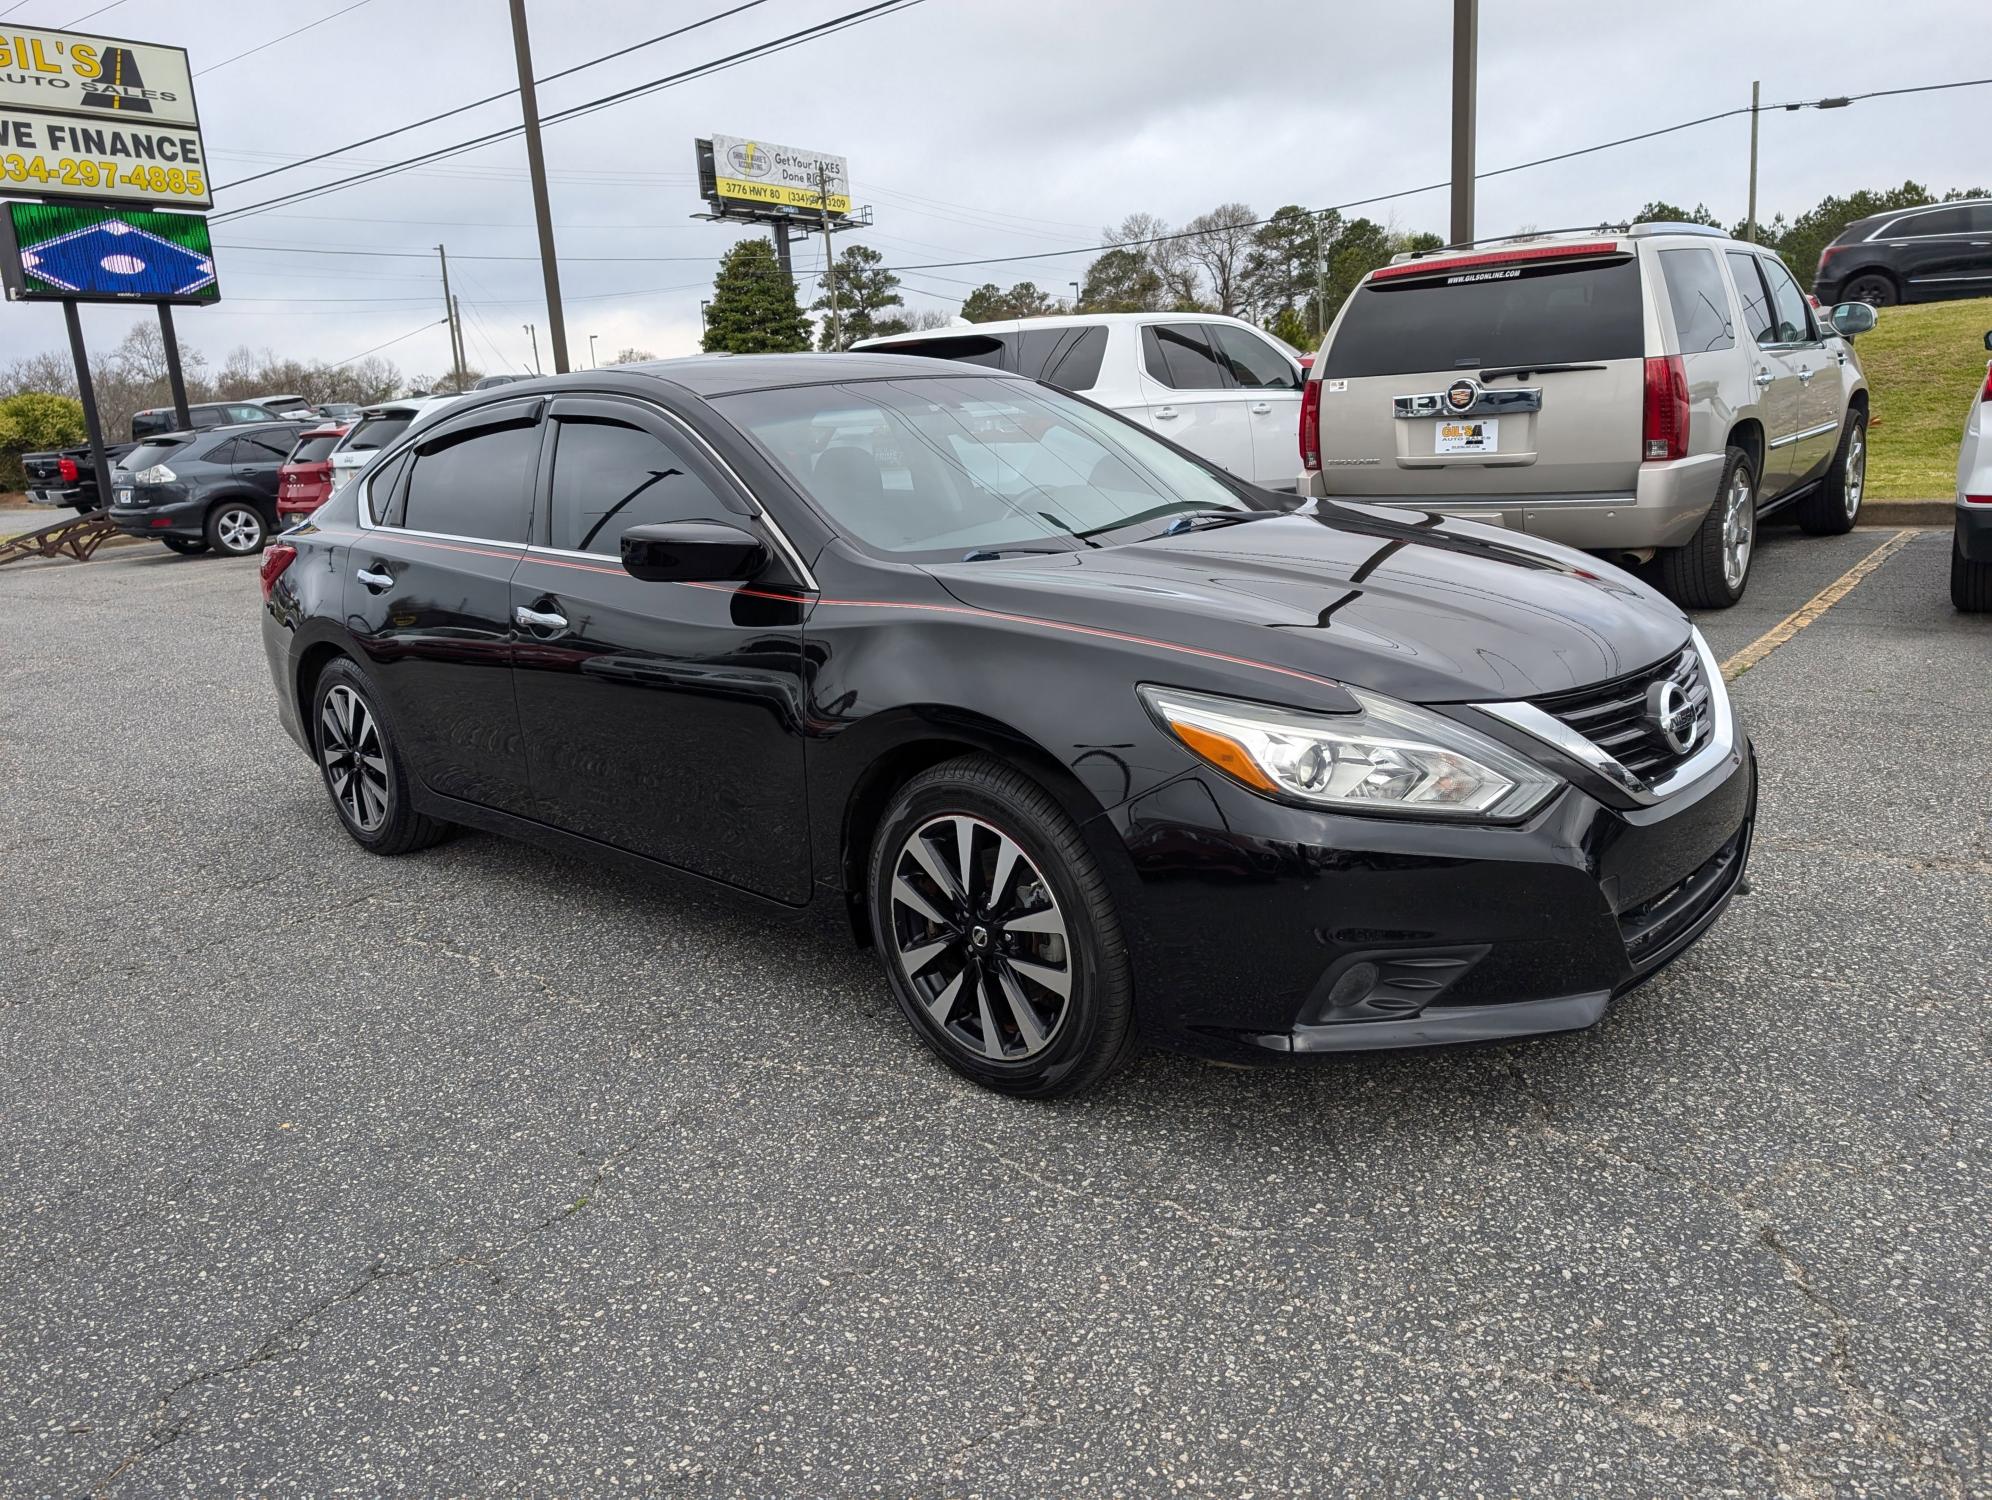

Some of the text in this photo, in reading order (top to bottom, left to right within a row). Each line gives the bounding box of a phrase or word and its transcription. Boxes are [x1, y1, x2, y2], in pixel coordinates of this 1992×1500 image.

[0, 73, 177, 101] UTO SALES
[46, 124, 200, 164] FINANCE
[775, 153, 840, 174] Get Your TAXES
[782, 169, 804, 182] Done
[726, 183, 748, 195] 3776
[749, 186, 768, 198] HWY
[770, 188, 780, 199] 80
[1447, 270, 1521, 284] WWW.GILSONLINE.COM
[1442, 425, 1473, 437] GIL'S
